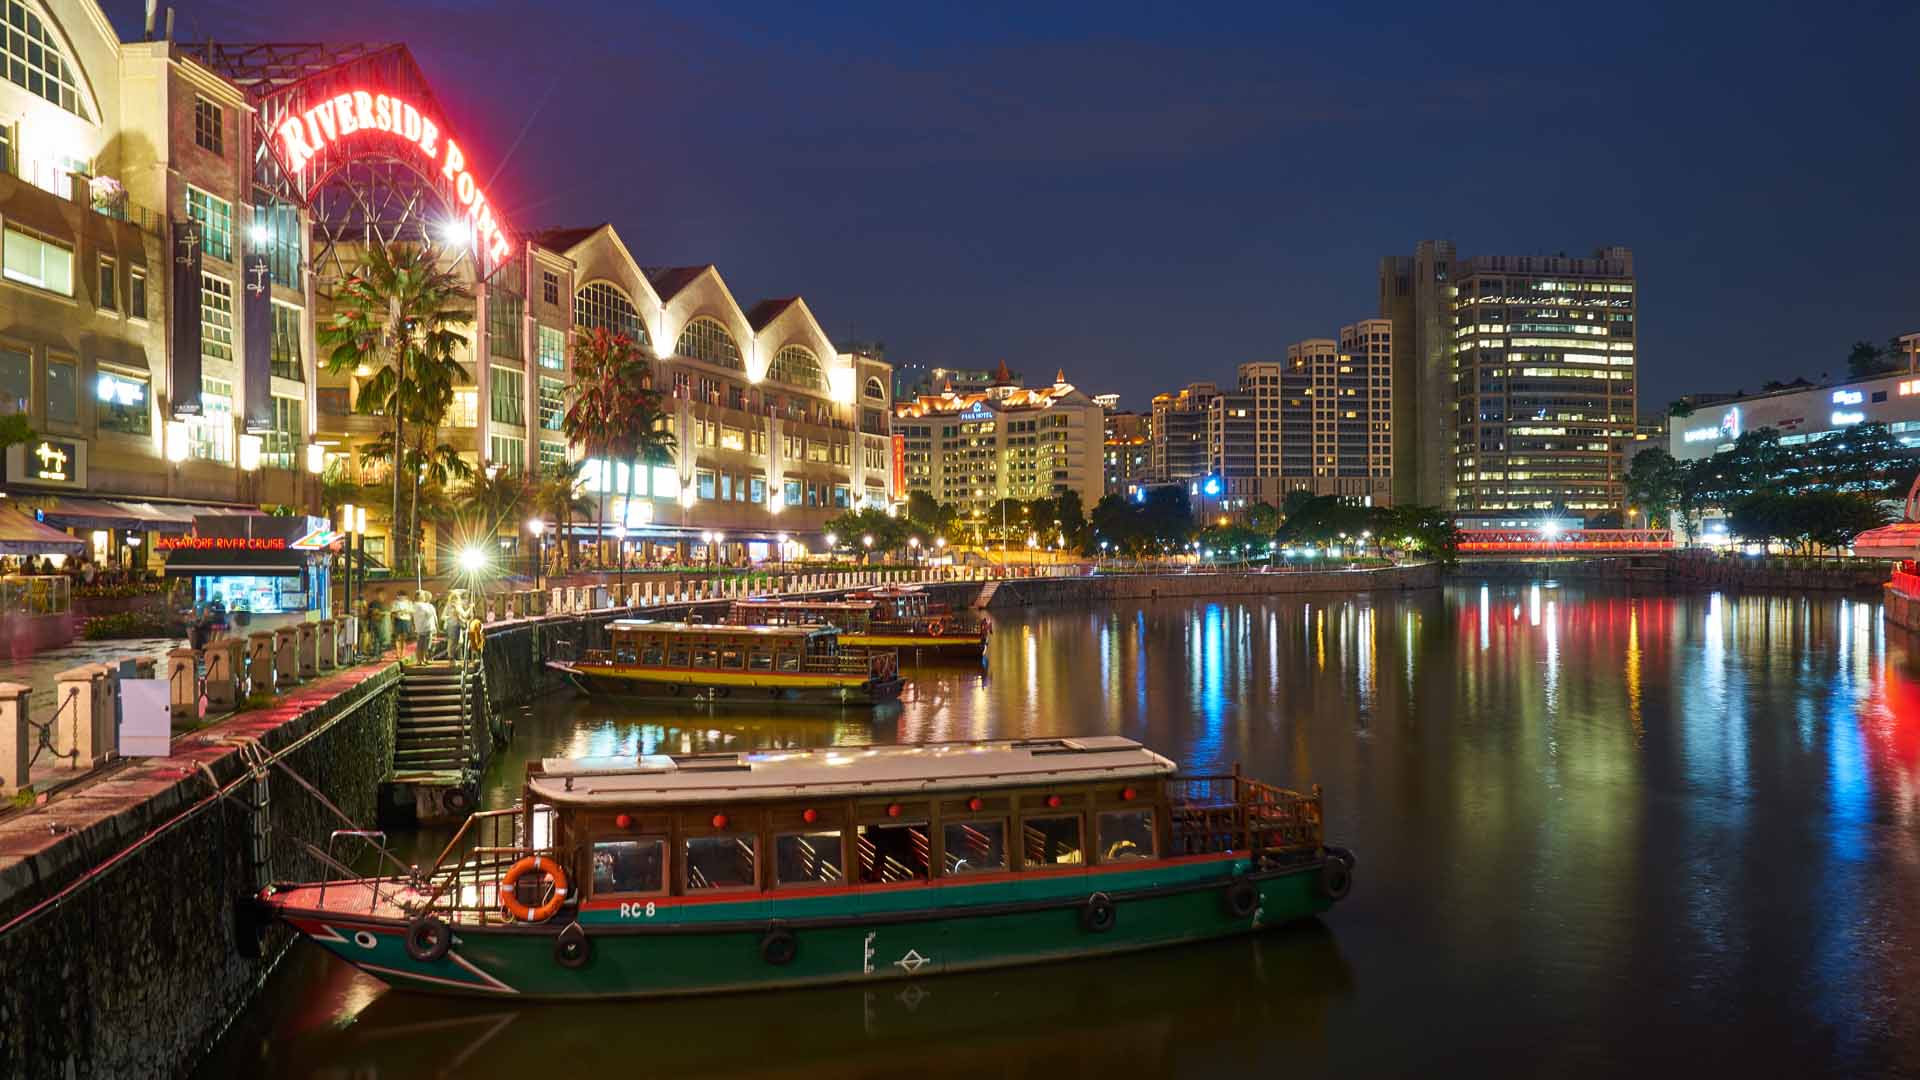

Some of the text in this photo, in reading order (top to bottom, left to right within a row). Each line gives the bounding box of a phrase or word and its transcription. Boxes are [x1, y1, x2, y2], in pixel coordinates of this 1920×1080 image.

[278, 90, 511, 264] RIVERSIDE POINT
[976, 411, 993, 419] HOTEL
[216, 536, 246, 550] RIVER
[249, 536, 286, 550] CRUISE
[620, 901, 656, 919] RC 8
